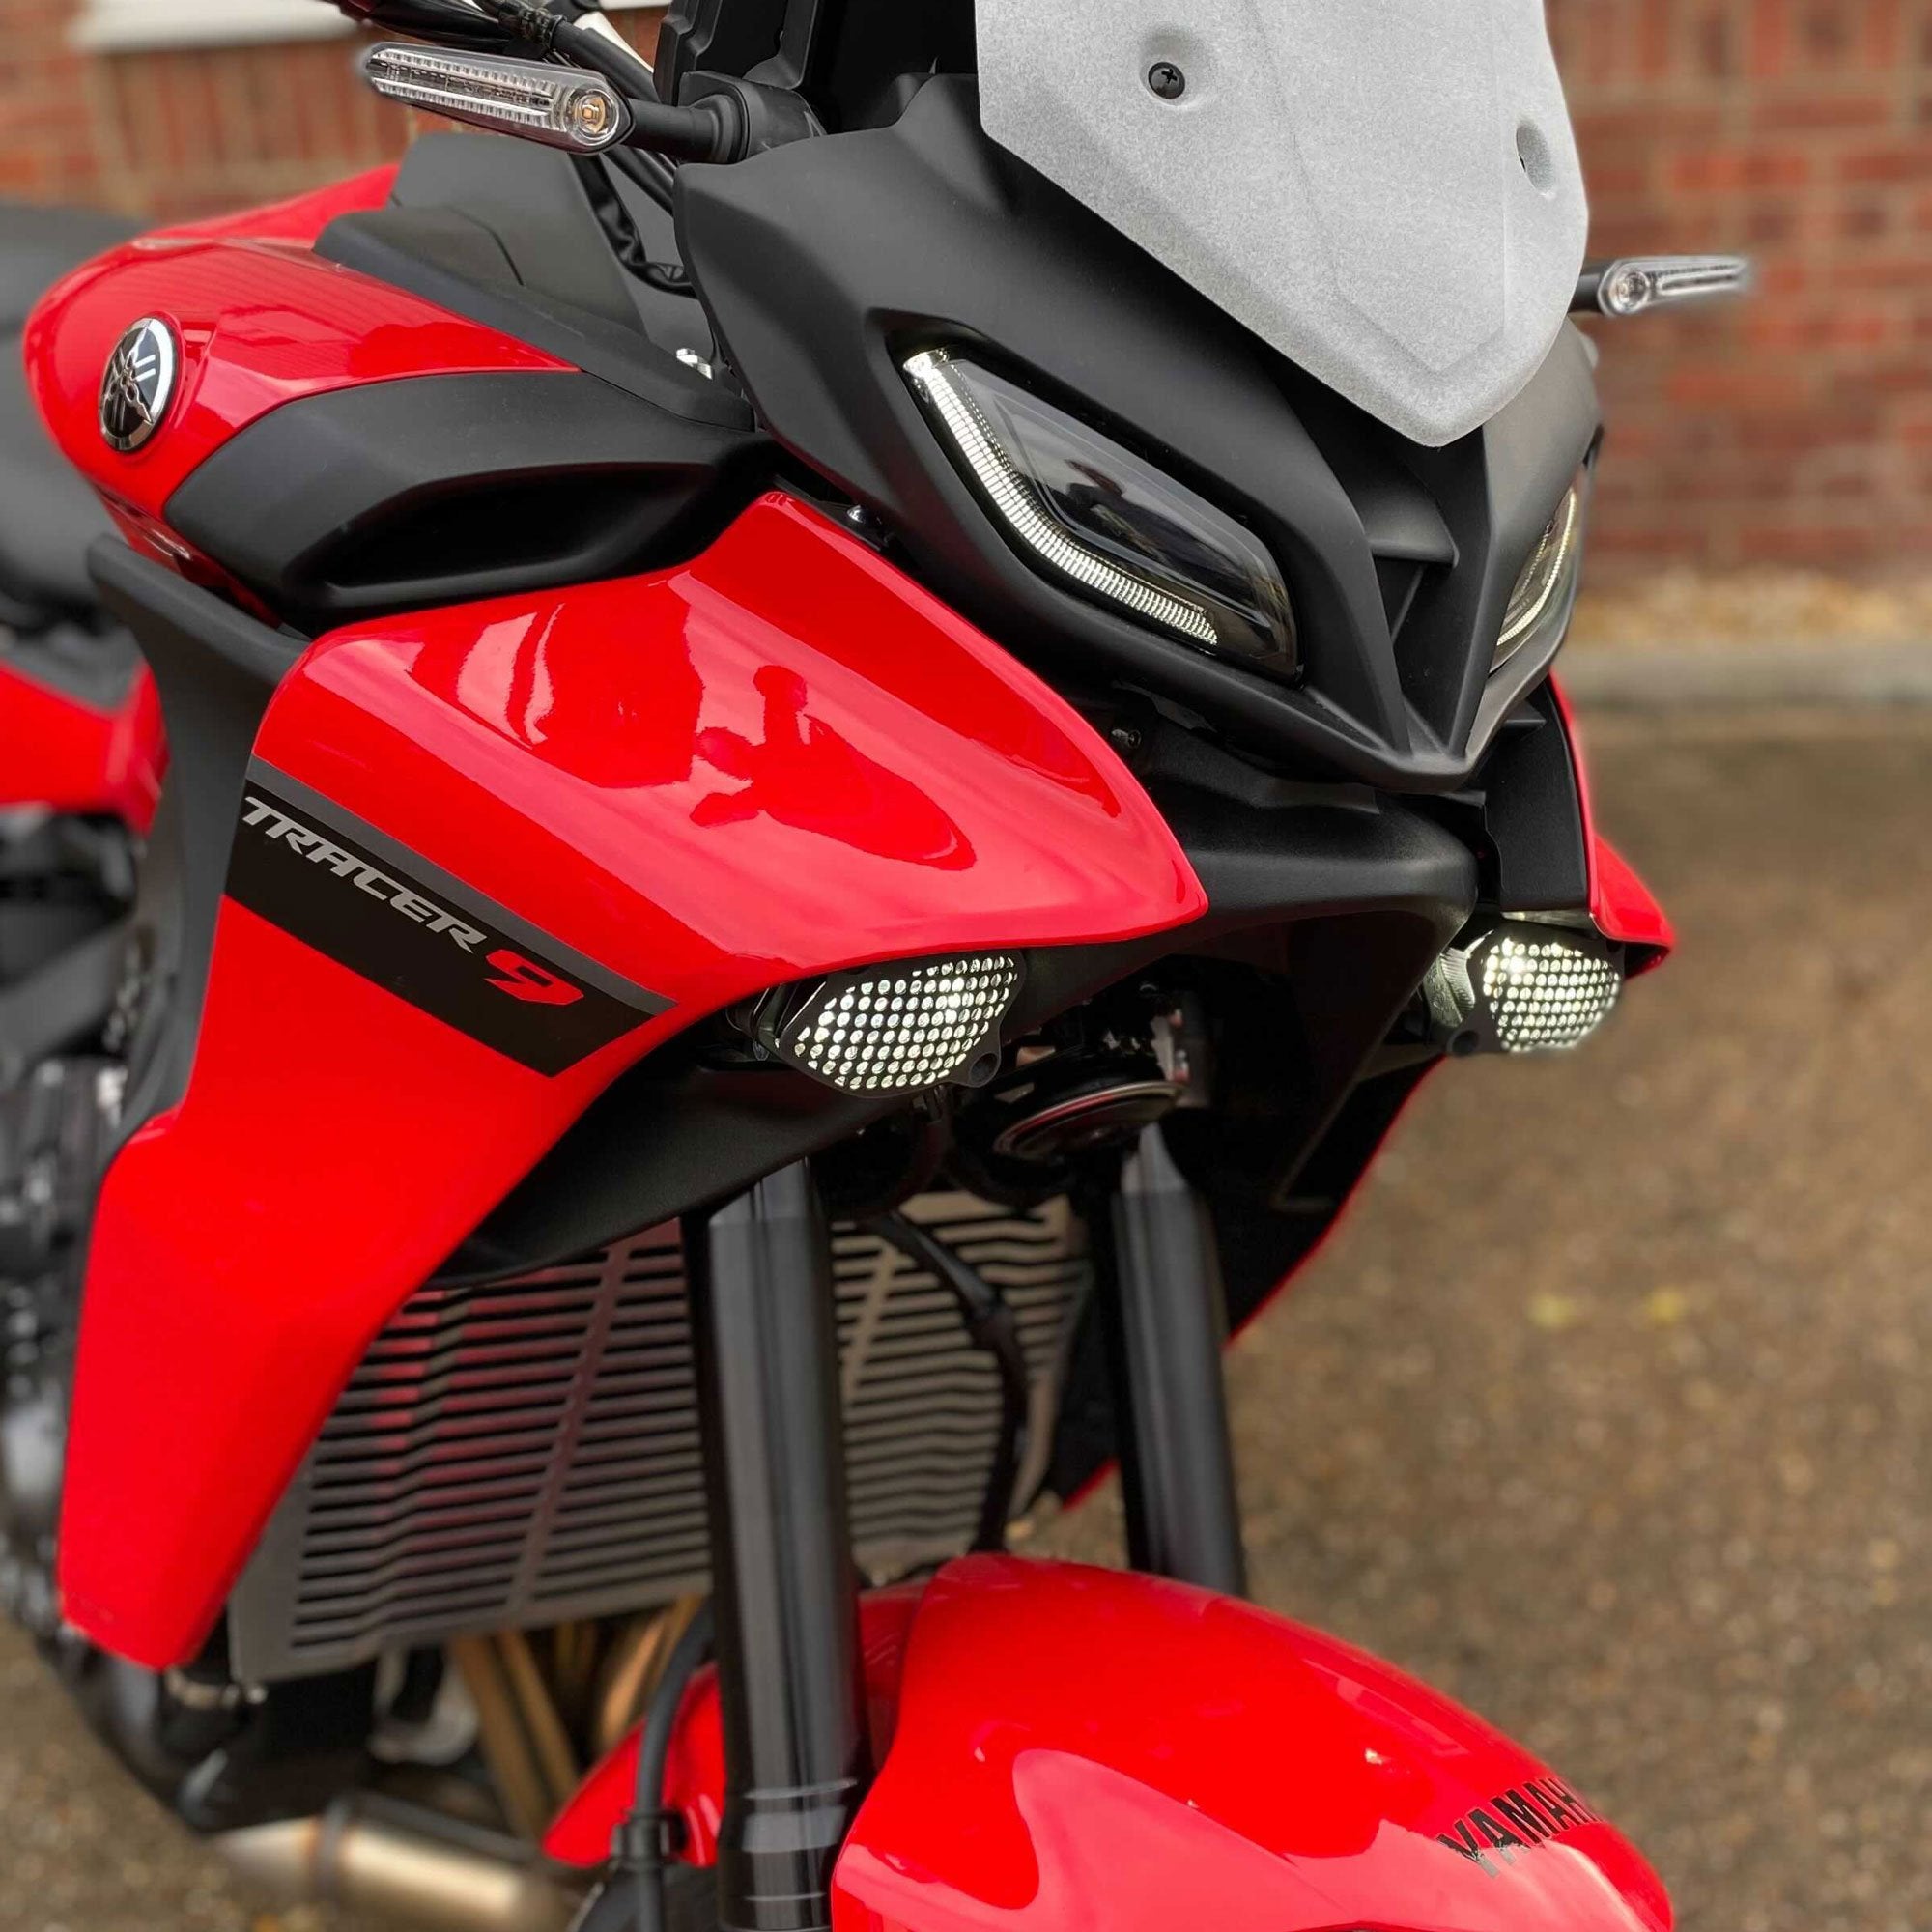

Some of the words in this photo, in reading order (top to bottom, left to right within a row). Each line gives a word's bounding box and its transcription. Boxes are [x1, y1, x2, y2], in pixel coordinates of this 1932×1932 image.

[242, 796, 487, 953] TRACER
[483, 949, 584, 1006] 9
[1436, 1777, 1600, 1877] YAMAH
